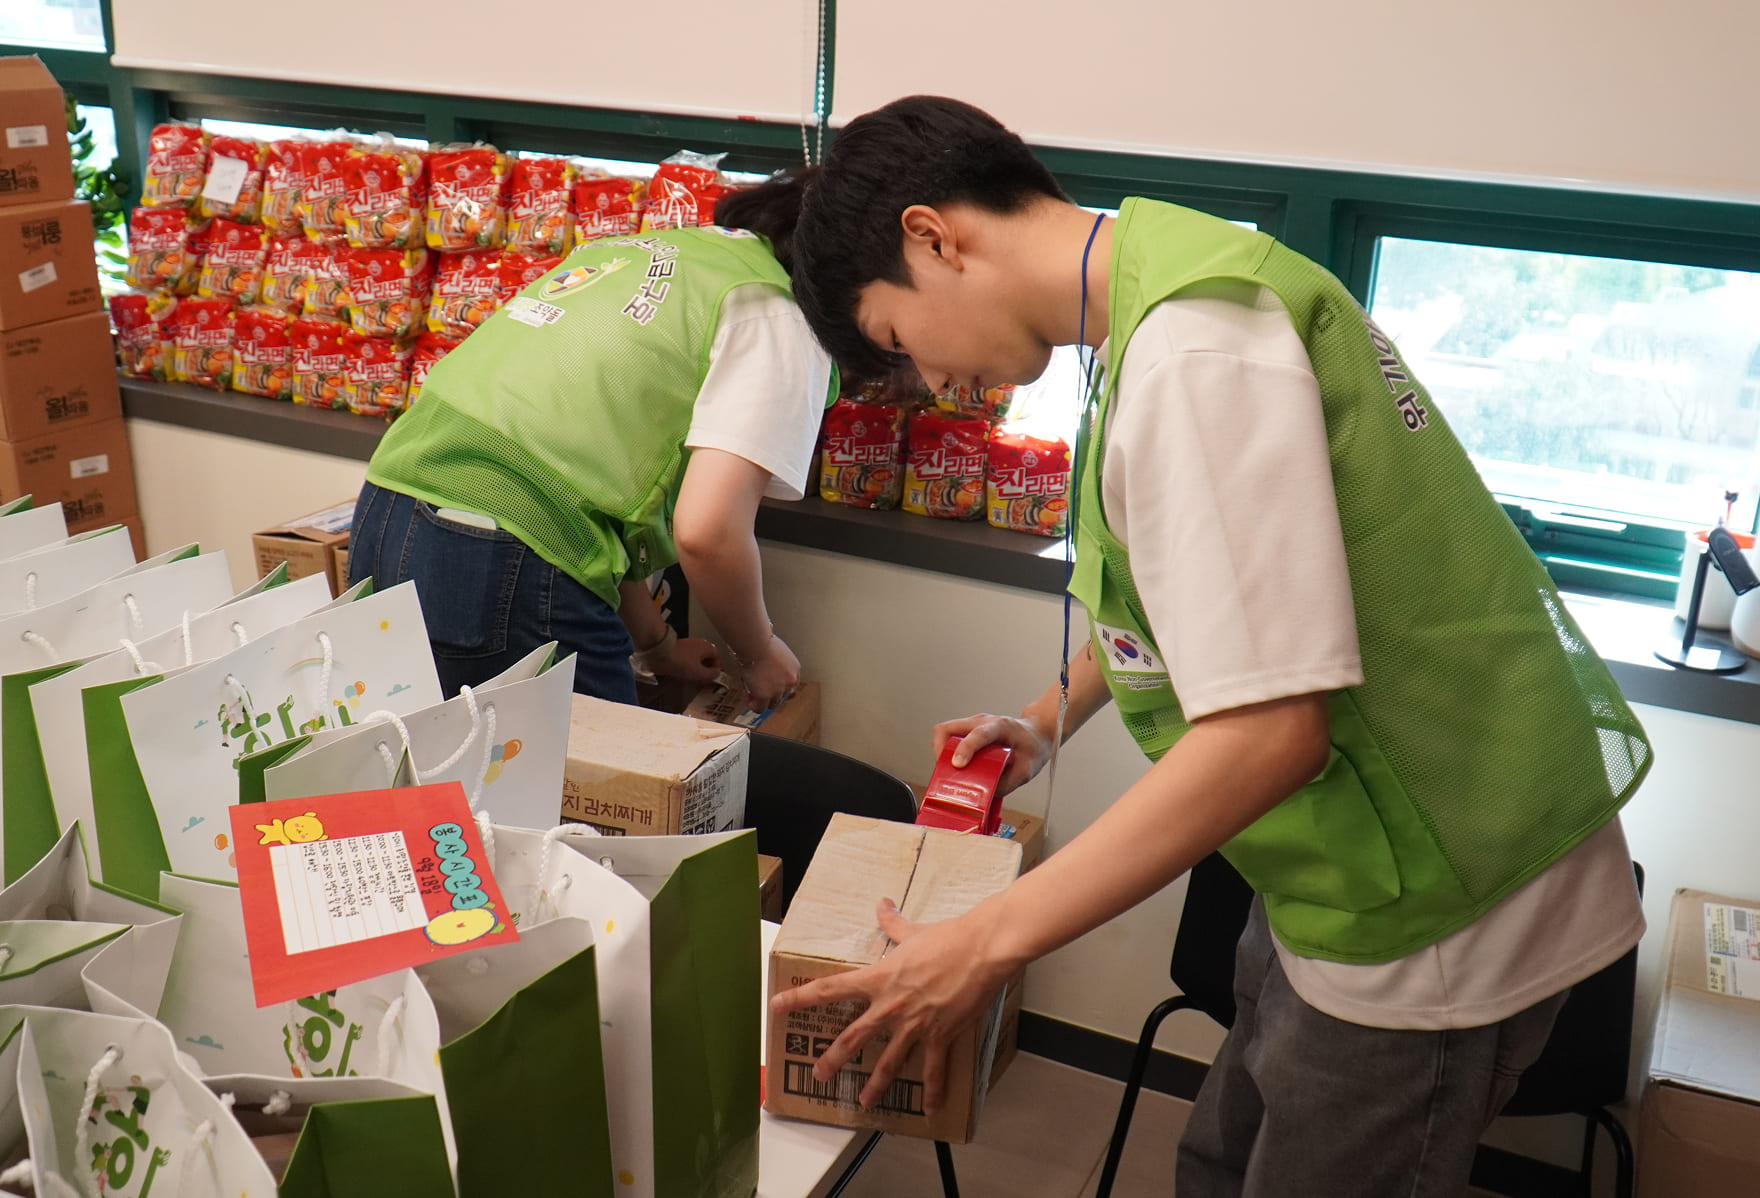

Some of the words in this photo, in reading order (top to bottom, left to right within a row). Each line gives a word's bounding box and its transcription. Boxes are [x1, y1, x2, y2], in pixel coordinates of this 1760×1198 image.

[150, 150, 198, 177] 진라면
[268, 171, 302, 194] 진라
[347, 186, 405, 218] 진라면
[511, 189, 562, 222] 진라면
[580, 209, 631, 240] 진라면
[131, 230, 183, 254] 진라면
[209, 243, 262, 267] 진라면
[350, 275, 403, 306] 진라면
[439, 269, 496, 297] 진라면
[178, 323, 231, 349] 진라면
[236, 339, 290, 365] 진라면
[294, 348, 344, 375] 진라면
[347, 357, 398, 384] 진라면
[828, 436, 892, 467] 진라면
[914, 448, 984, 481] 진라면
[995, 467, 1067, 500] 진라면
[562, 795, 580, 812] 지
[584, 797, 653, 826] 김치찌개
[416, 857, 434, 873] 9월
[435, 827, 478, 904] 봉사시간표
[421, 875, 442, 894] 18일
